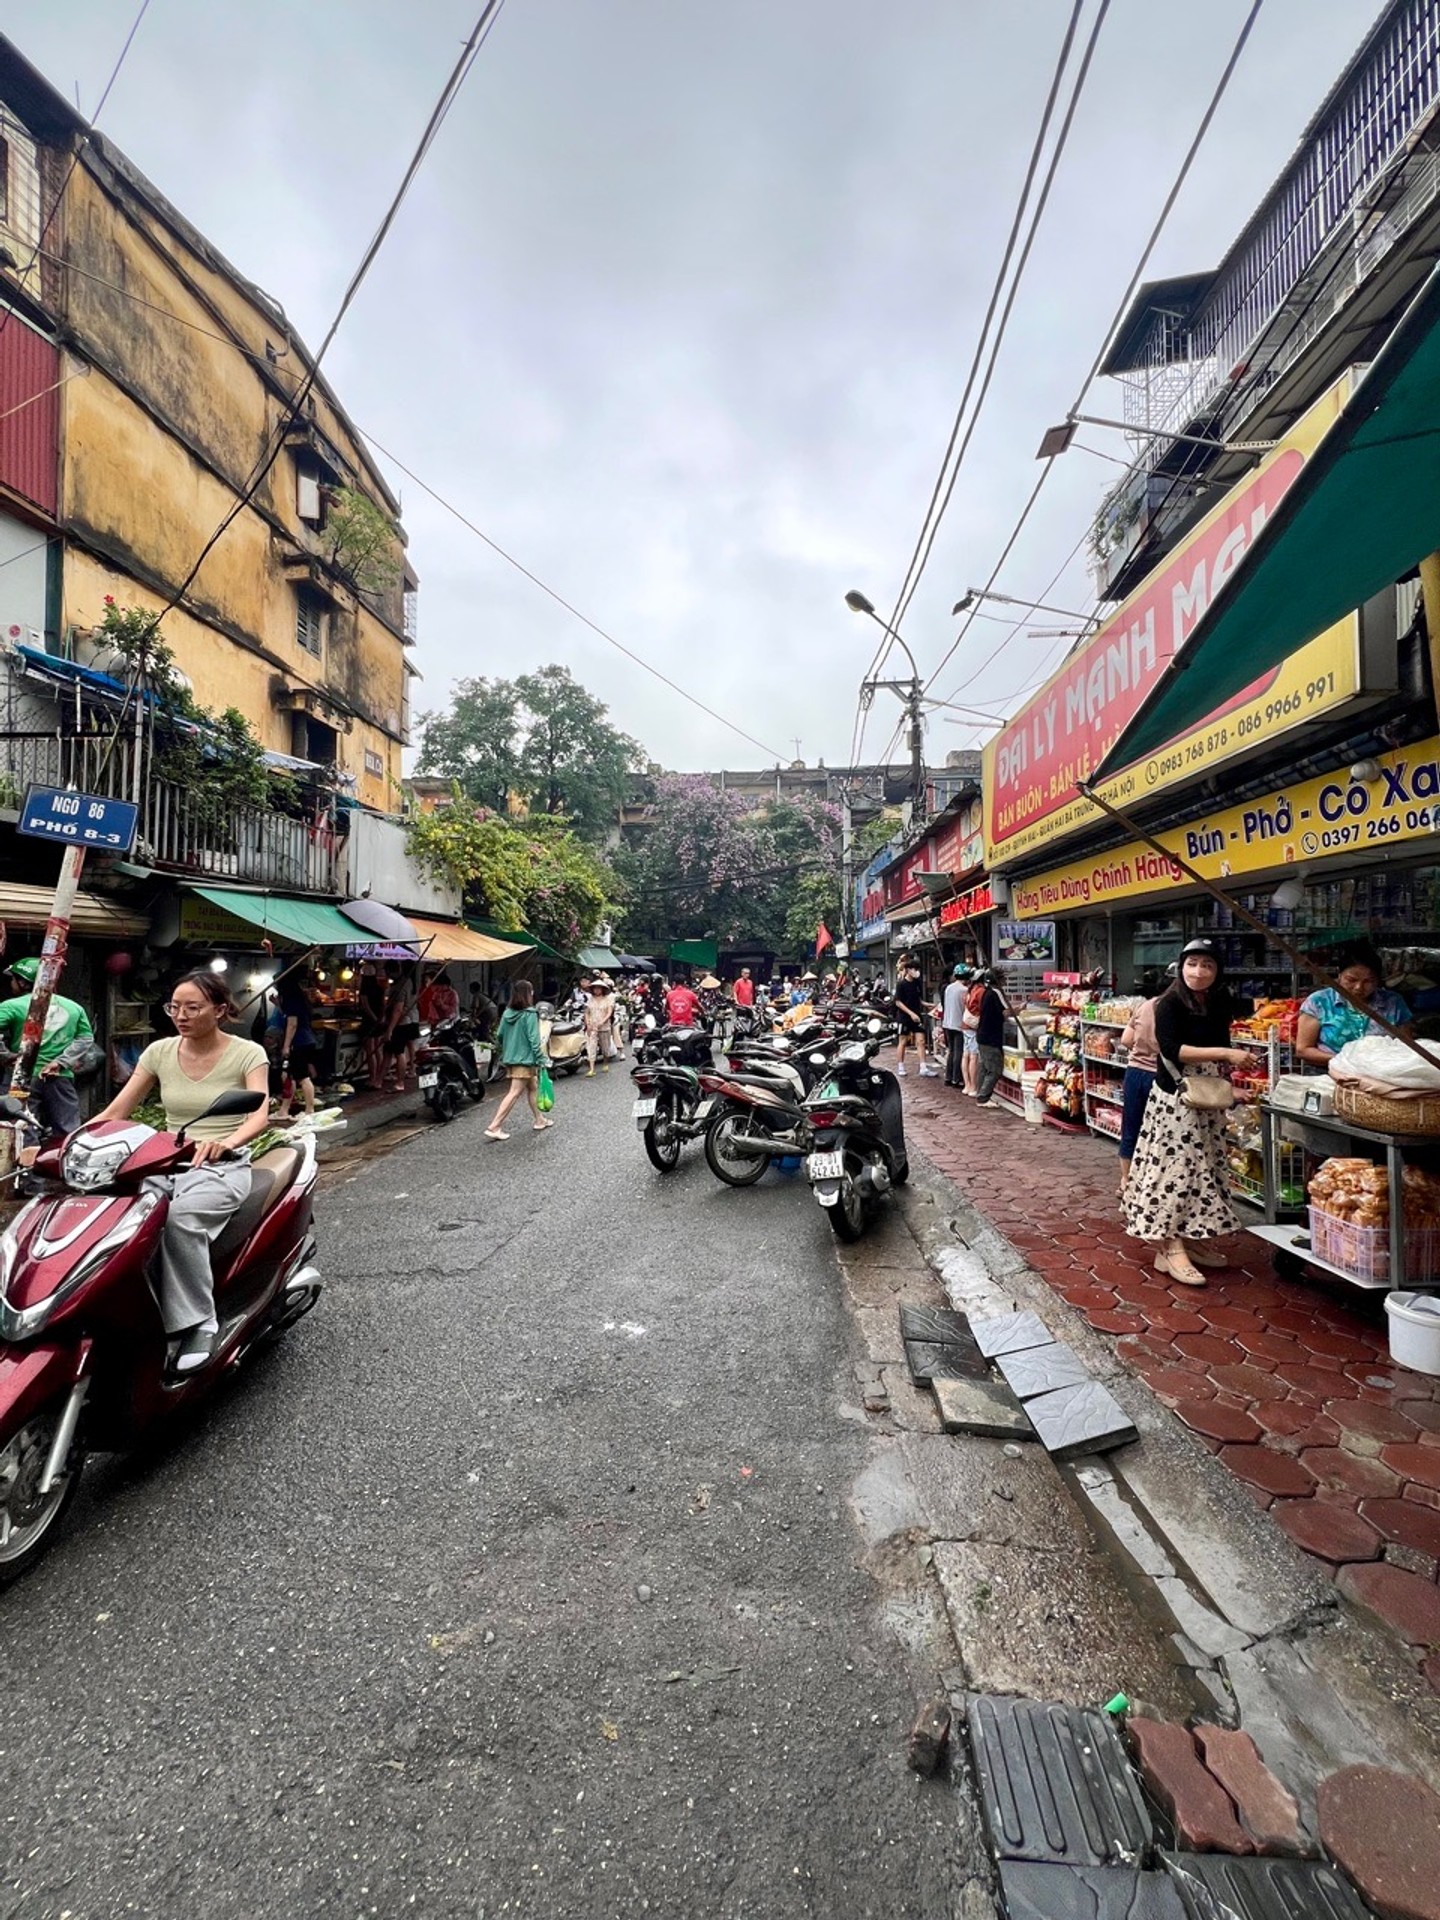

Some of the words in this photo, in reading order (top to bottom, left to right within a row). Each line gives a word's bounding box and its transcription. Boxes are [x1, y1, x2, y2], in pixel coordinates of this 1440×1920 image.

[998, 728, 1028, 791] ĐẠI
[1033, 690, 1057, 761] LÝ
[1065, 606, 1157, 735] MẠNH
[1159, 752, 1183, 776] 0983
[1207, 729, 1228, 752] 878
[1237, 711, 1261, 738] 086
[1265, 690, 1301, 723] 9966
[1306, 672, 1335, 703] 991
[29, 818, 79, 836] PHỐ
[84, 829, 121, 844] 8-3
[51, 796, 80, 816] NGÕ
[88, 803, 105, 820] 86
[998, 803, 1016, 832] BÁN
[1016, 785, 1042, 821] BUÔN
[1050, 762, 1074, 800] BÁN
[1322, 824, 1360, 848] 0397
[1366, 815, 1401, 838] 266
[1016, 890, 1039, 912] Hàng
[1060, 876, 1090, 900] Dùng
[1092, 861, 1132, 893] Chính
[1186, 824, 1225, 859] Bún
[1243, 796, 1293, 844] Phở
